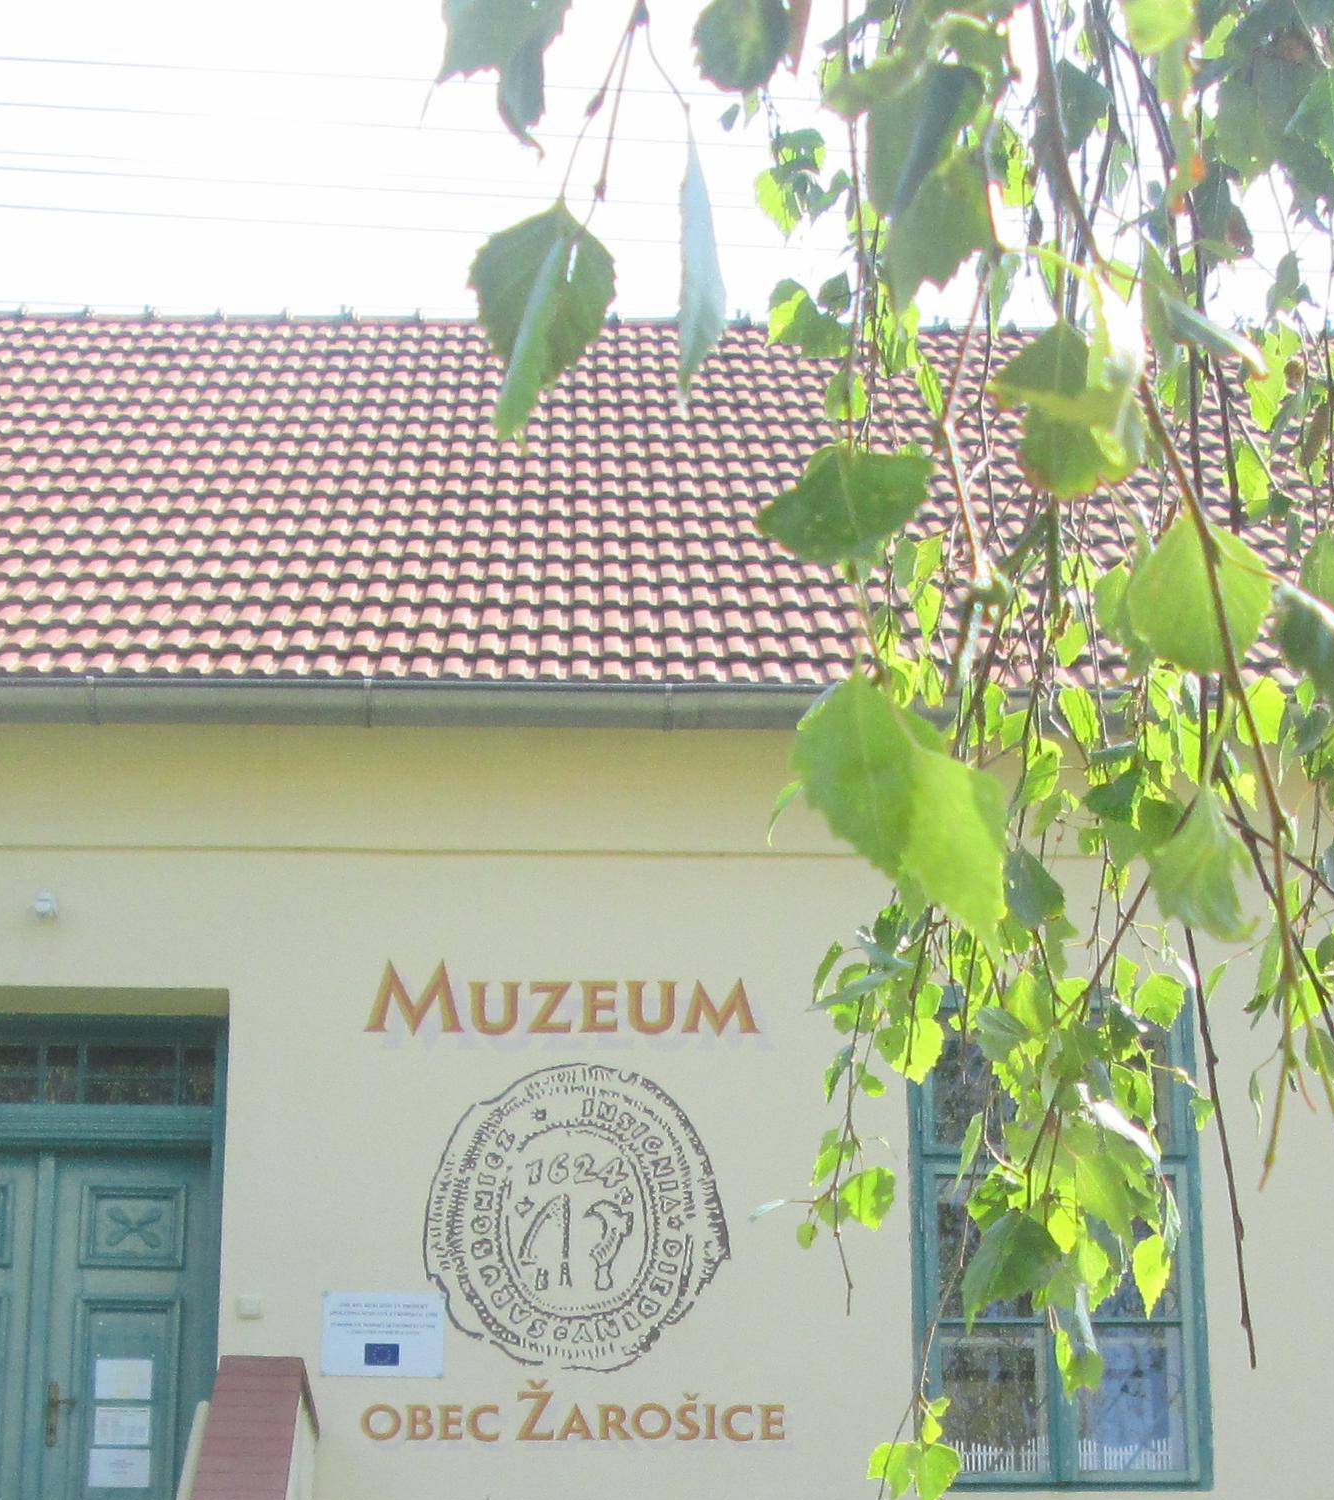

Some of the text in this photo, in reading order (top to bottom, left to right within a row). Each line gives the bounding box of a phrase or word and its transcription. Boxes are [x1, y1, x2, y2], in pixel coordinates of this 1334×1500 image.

[363, 958, 761, 1037] MUZEUM
[525, 1153, 629, 1188] 1624
[360, 1378, 785, 1442] OBEC ŽAROŠICE
